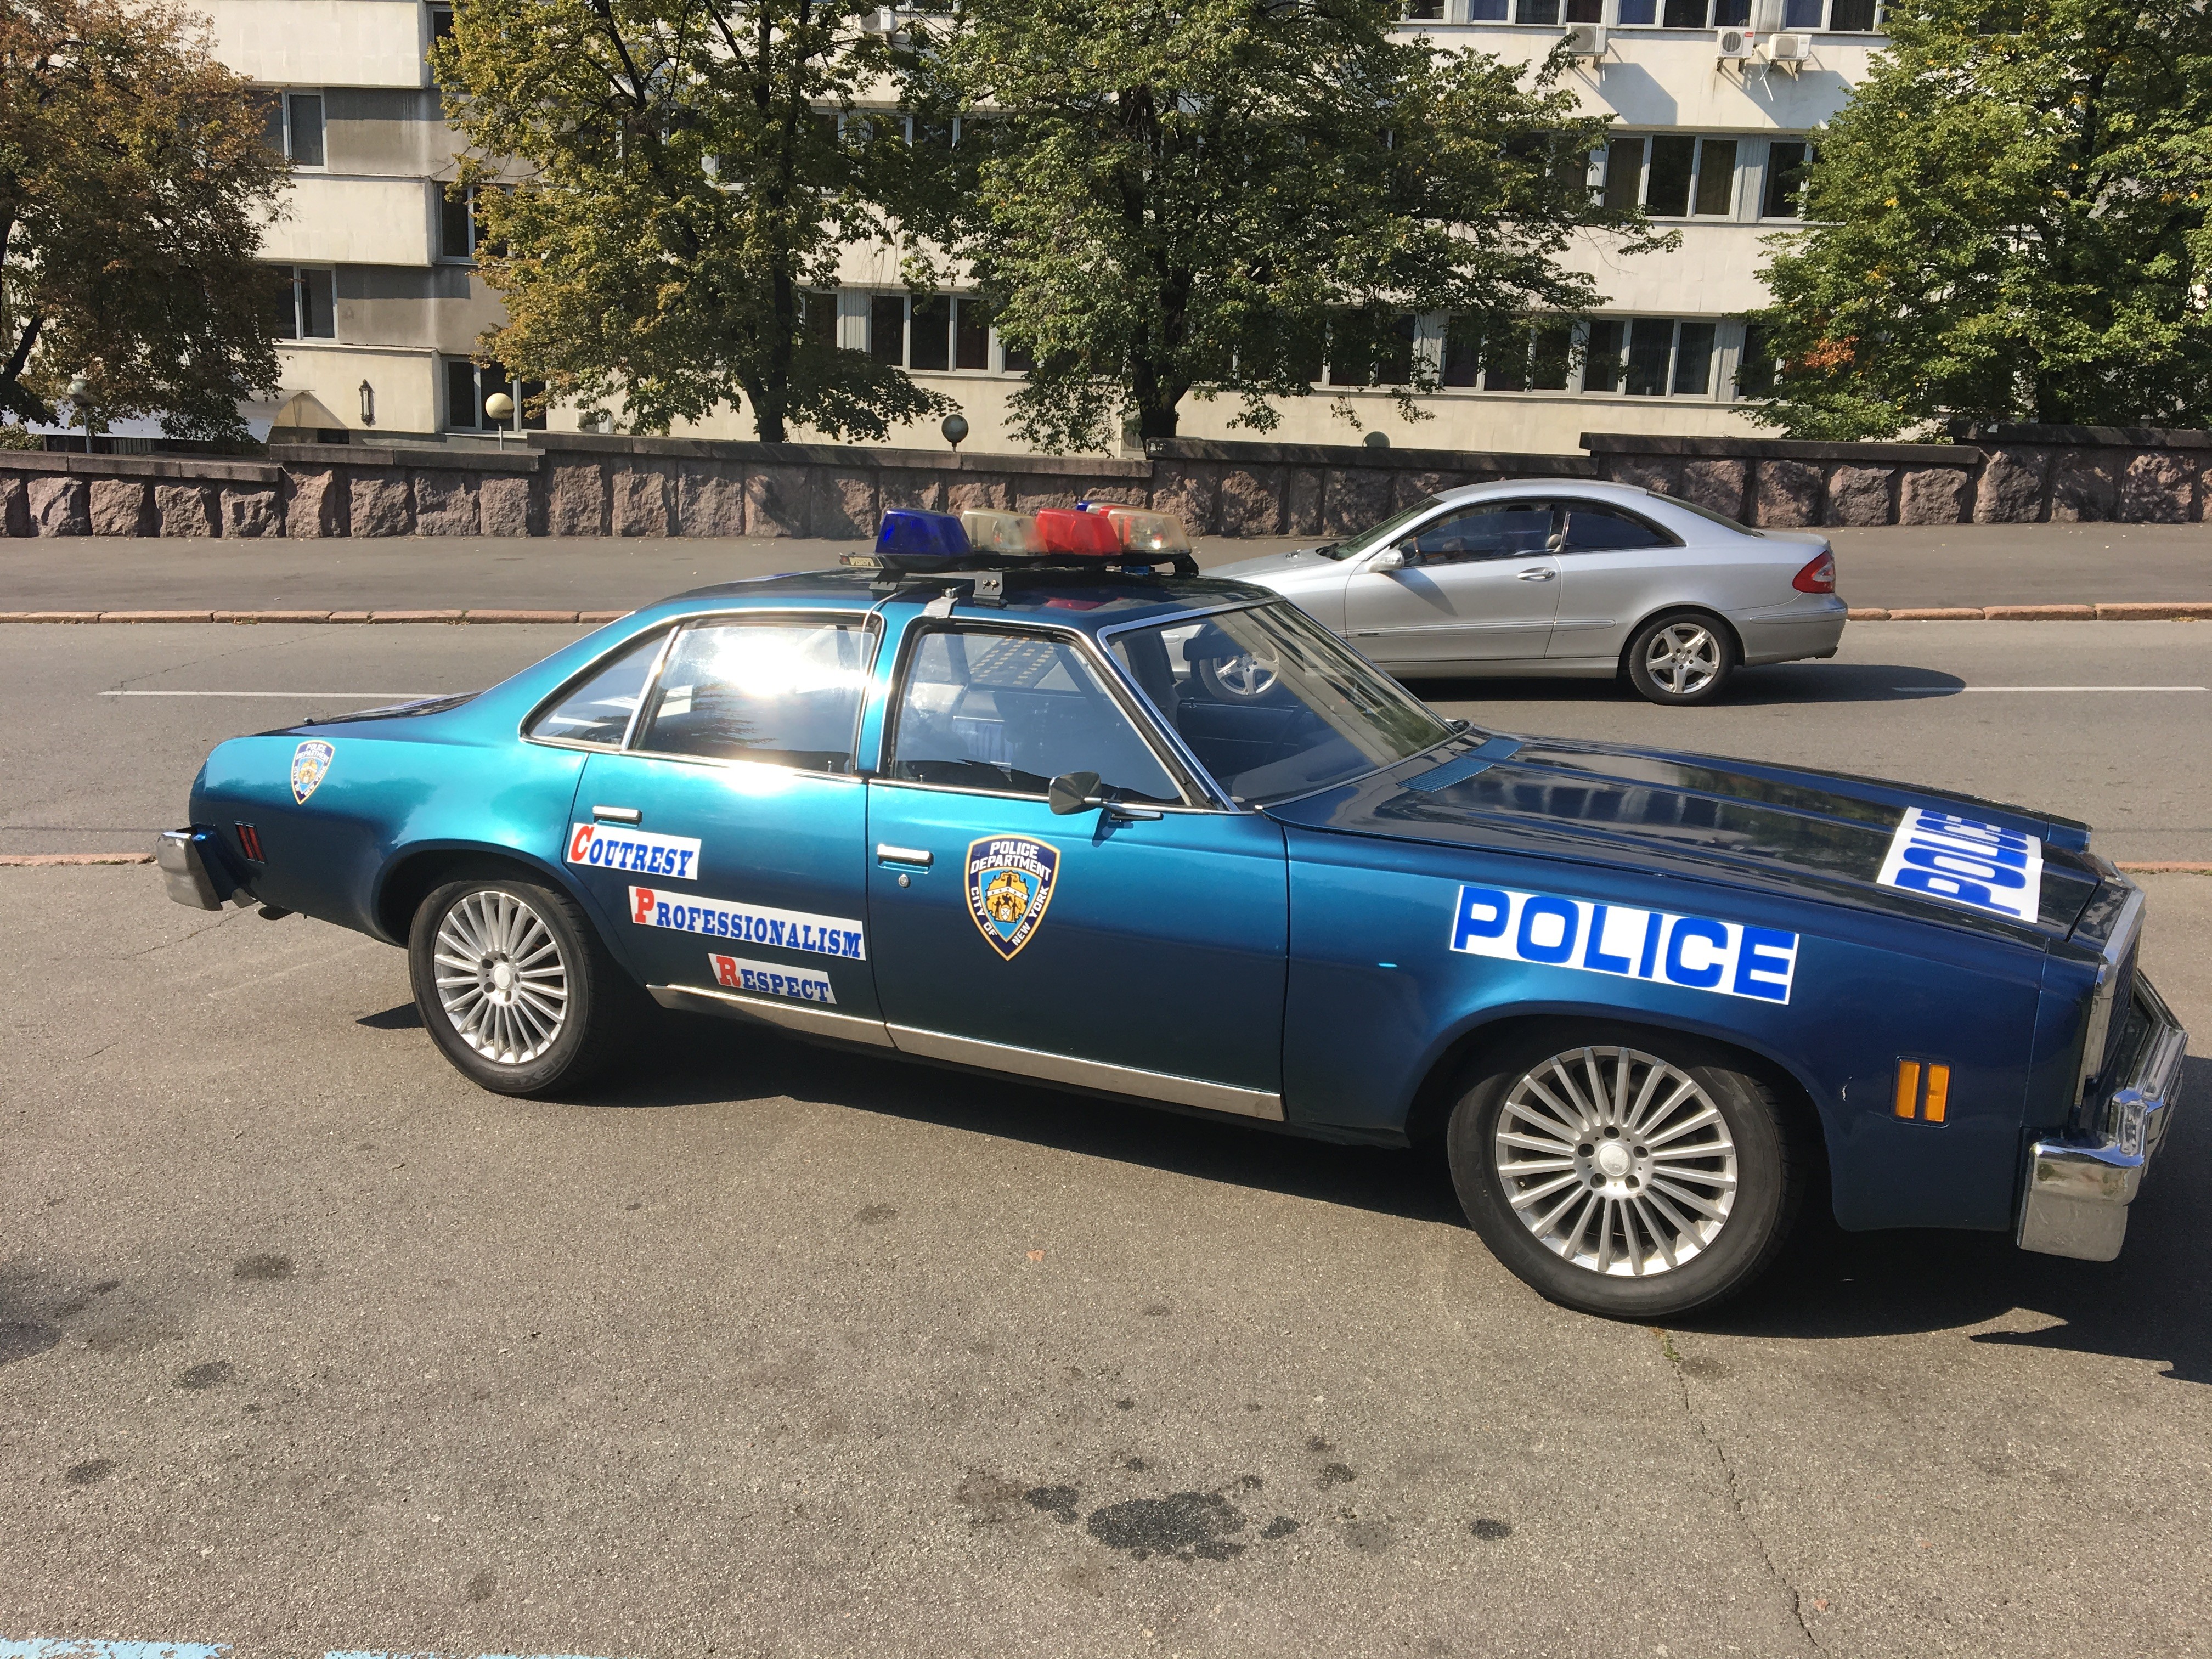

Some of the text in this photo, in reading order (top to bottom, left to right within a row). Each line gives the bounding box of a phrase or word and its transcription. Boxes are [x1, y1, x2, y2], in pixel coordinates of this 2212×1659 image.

[296, 751, 329, 763] DEPARTMENT
[306, 743, 327, 753] POLICE
[304, 783, 314, 796] NEW
[571, 825, 693, 877] COUTRESY
[970, 855, 1051, 881] DEPARTMENT
[990, 841, 1039, 859] POLICE
[1894, 810, 2029, 917] POLICE
[635, 888, 862, 958] PROFESSIONALISM
[970, 887, 997, 937] CITY OF
[1011, 887, 1049, 946] NEW YORK
[1453, 886, 1796, 1001] POLICE
[716, 956, 829, 1002] RESPECT
